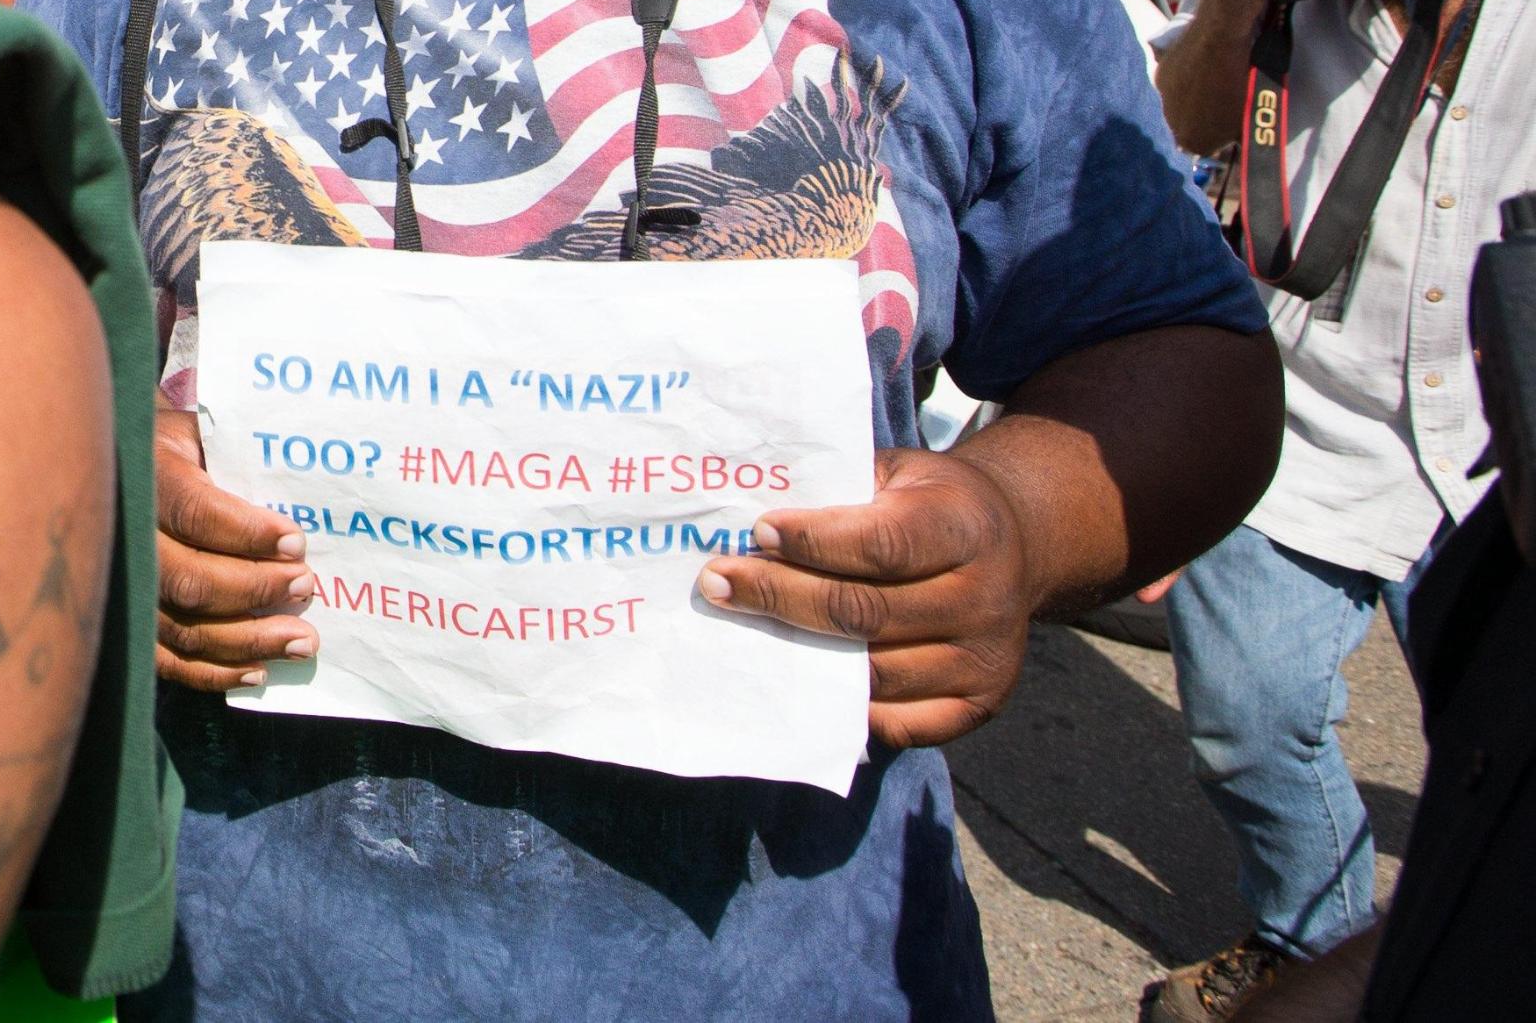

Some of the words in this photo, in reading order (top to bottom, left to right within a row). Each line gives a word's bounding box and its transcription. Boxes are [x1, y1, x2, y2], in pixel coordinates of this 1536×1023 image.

[1255, 89, 1277, 146] EOS
[252, 352, 312, 394] SO
[328, 360, 410, 405] AM
[429, 367, 440, 406] I
[458, 370, 494, 408] A
[252, 431, 382, 479] TOO?
[399, 445, 592, 493] #MAGA
[608, 454, 791, 494] #FSBos
[266, 502, 764, 566] BLACKSFORTRUMP
